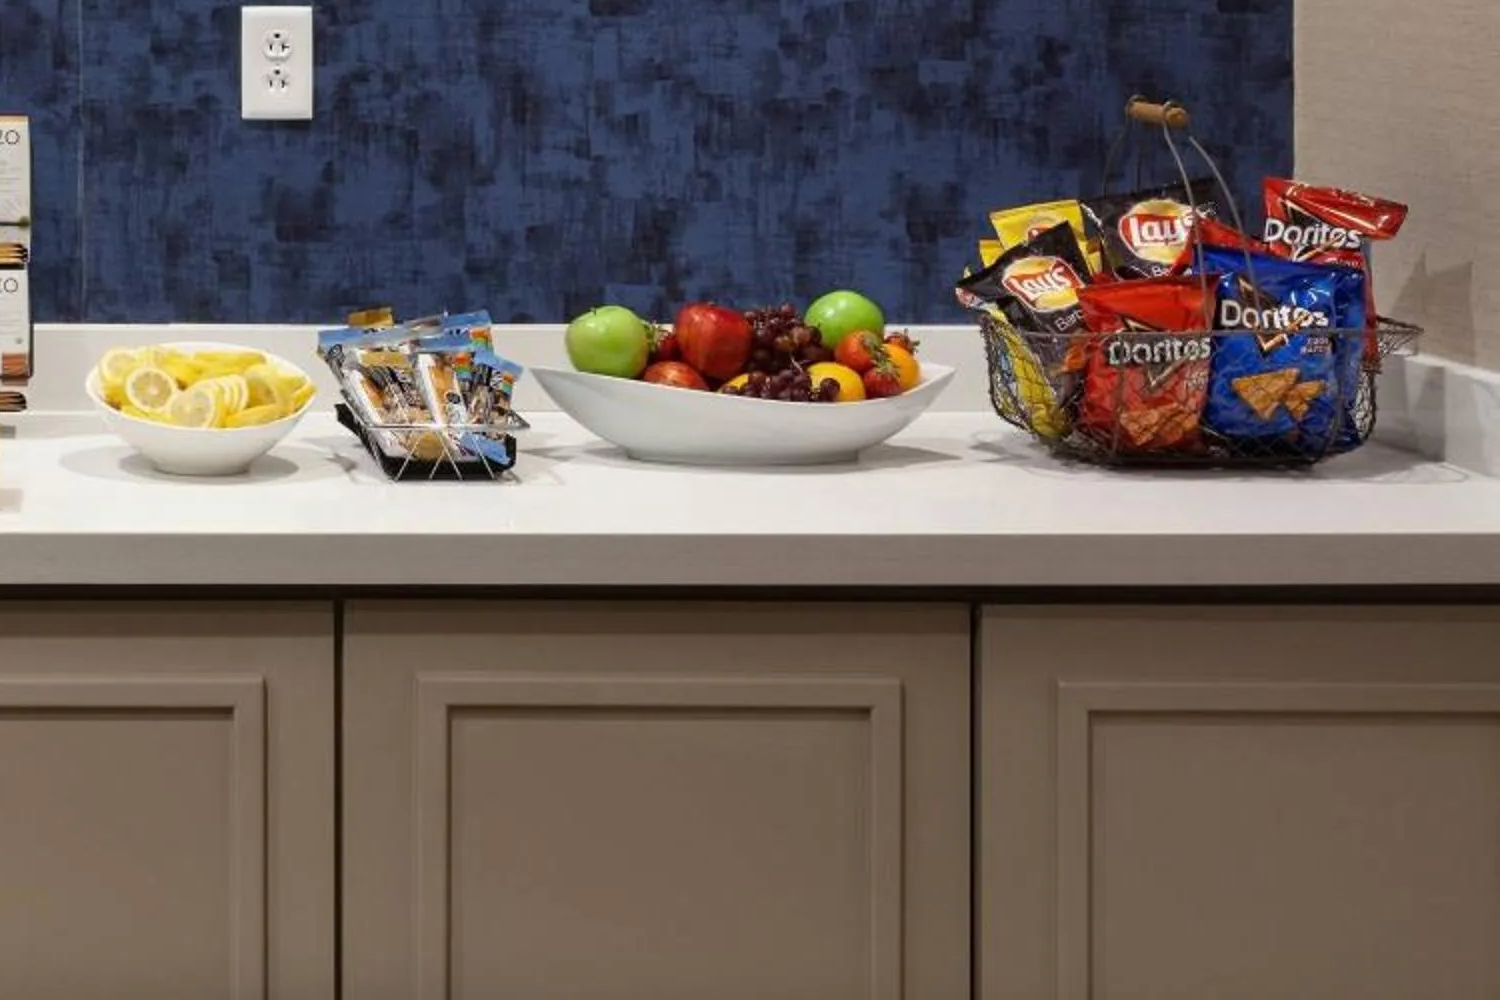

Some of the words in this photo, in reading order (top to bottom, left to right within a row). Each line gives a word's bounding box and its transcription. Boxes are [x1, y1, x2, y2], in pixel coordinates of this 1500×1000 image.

[1263, 217, 1363, 249] Doritos
[1220, 300, 1330, 330] Doritos
[1108, 337, 1211, 365] Doritos
